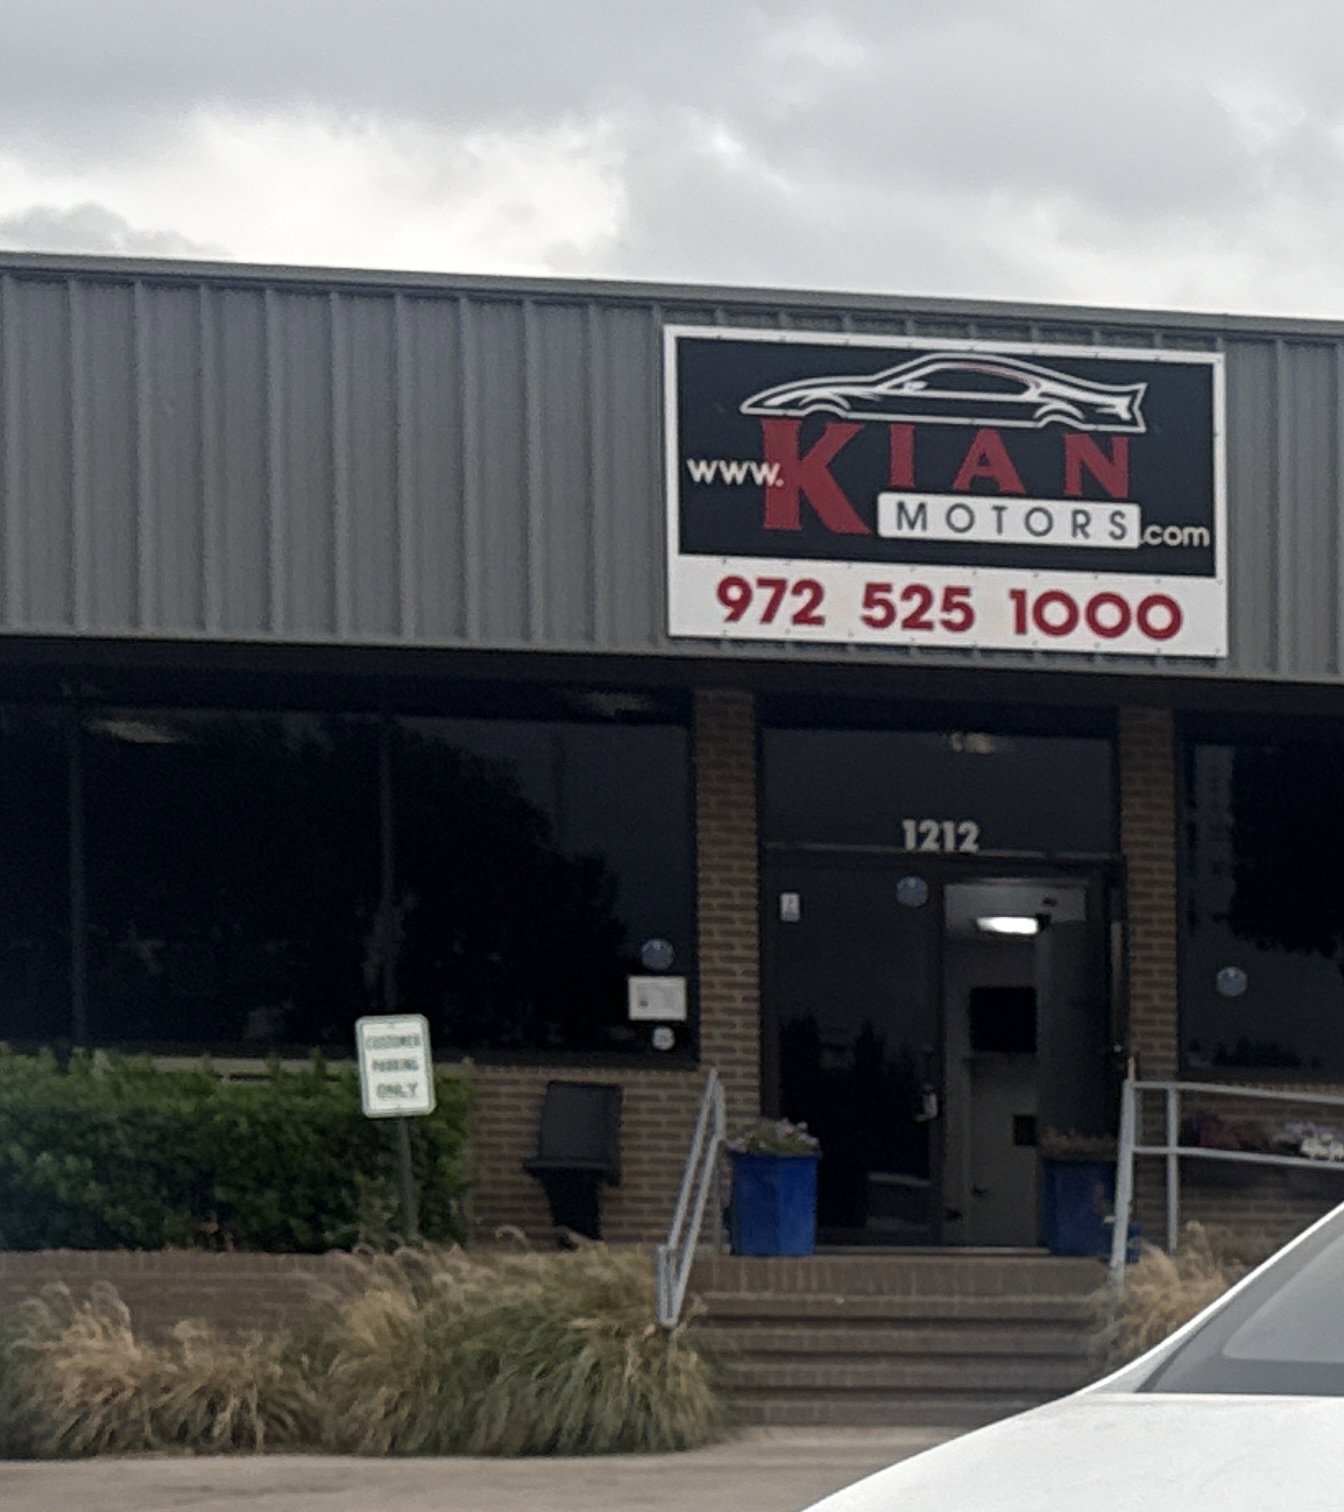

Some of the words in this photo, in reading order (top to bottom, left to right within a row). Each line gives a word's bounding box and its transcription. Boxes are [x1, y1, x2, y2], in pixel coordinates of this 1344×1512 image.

[687, 460, 784, 487] www.
[760, 416, 1130, 535] KIAN
[896, 501, 1128, 542] MOTORS
[1139, 523, 1210, 548] .com
[716, 575, 826, 625] 972
[861, 583, 976, 633] 525
[1009, 589, 1183, 641] 1000
[902, 819, 981, 853] 1212
